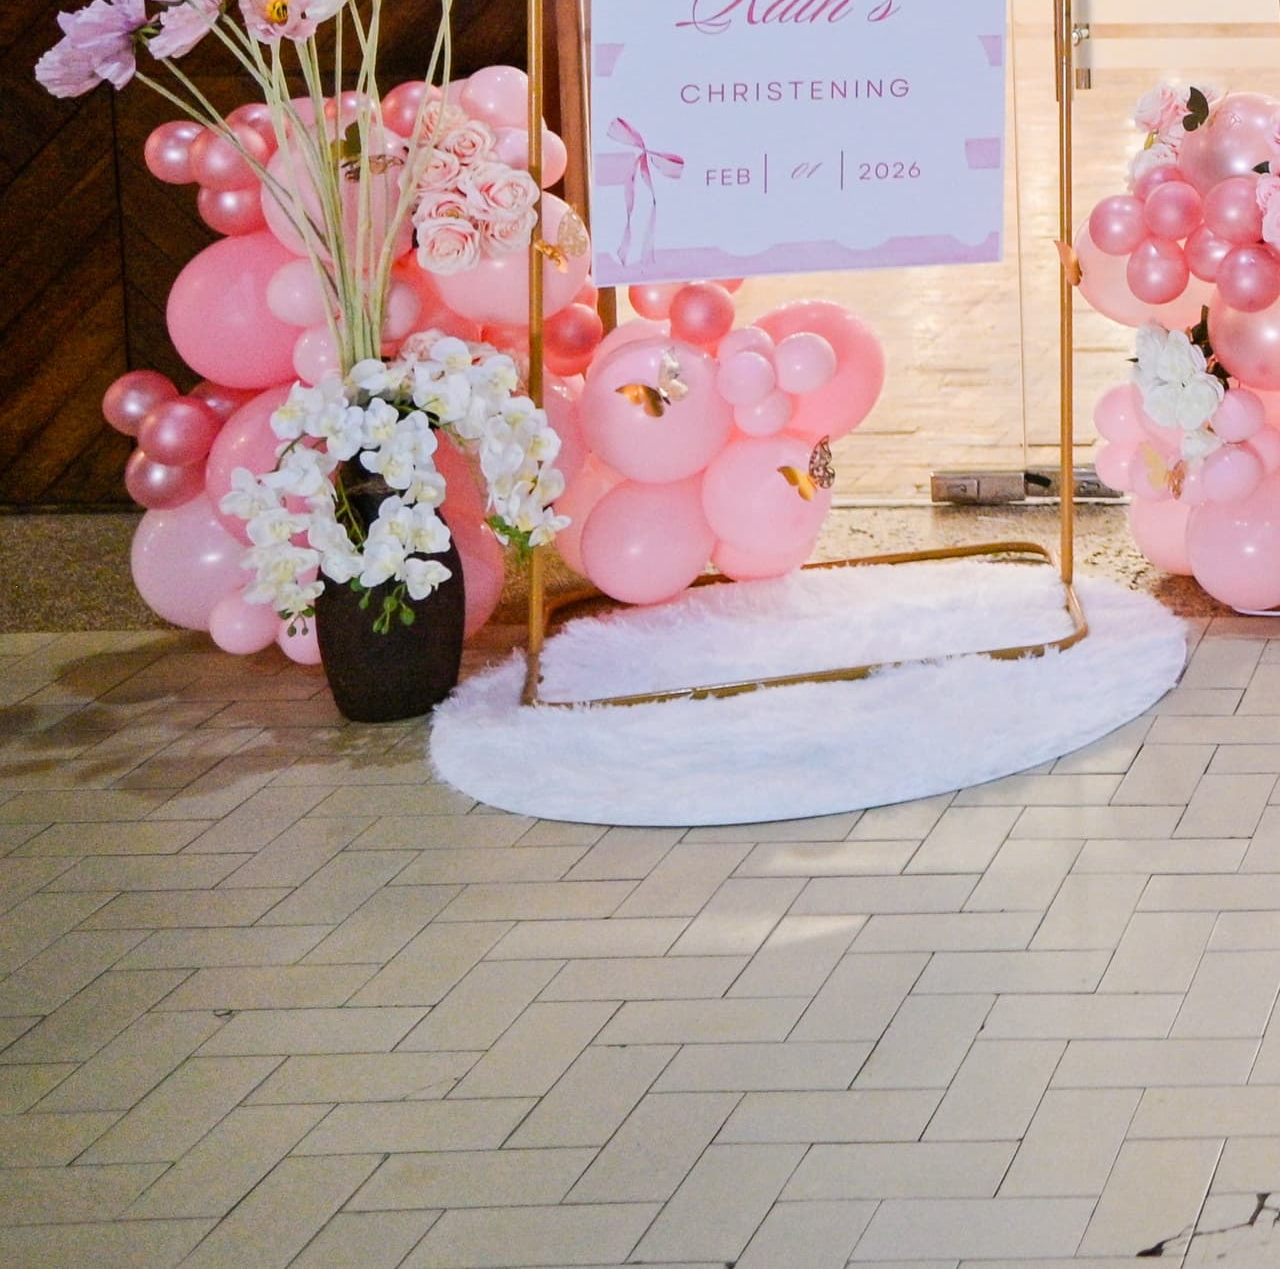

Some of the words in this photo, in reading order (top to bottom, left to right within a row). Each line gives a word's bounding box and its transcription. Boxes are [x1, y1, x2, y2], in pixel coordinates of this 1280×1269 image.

[680, 78, 911, 104] CHRISTENING
[705, 168, 751, 187] FEB
[858, 161, 922, 181] 2026
